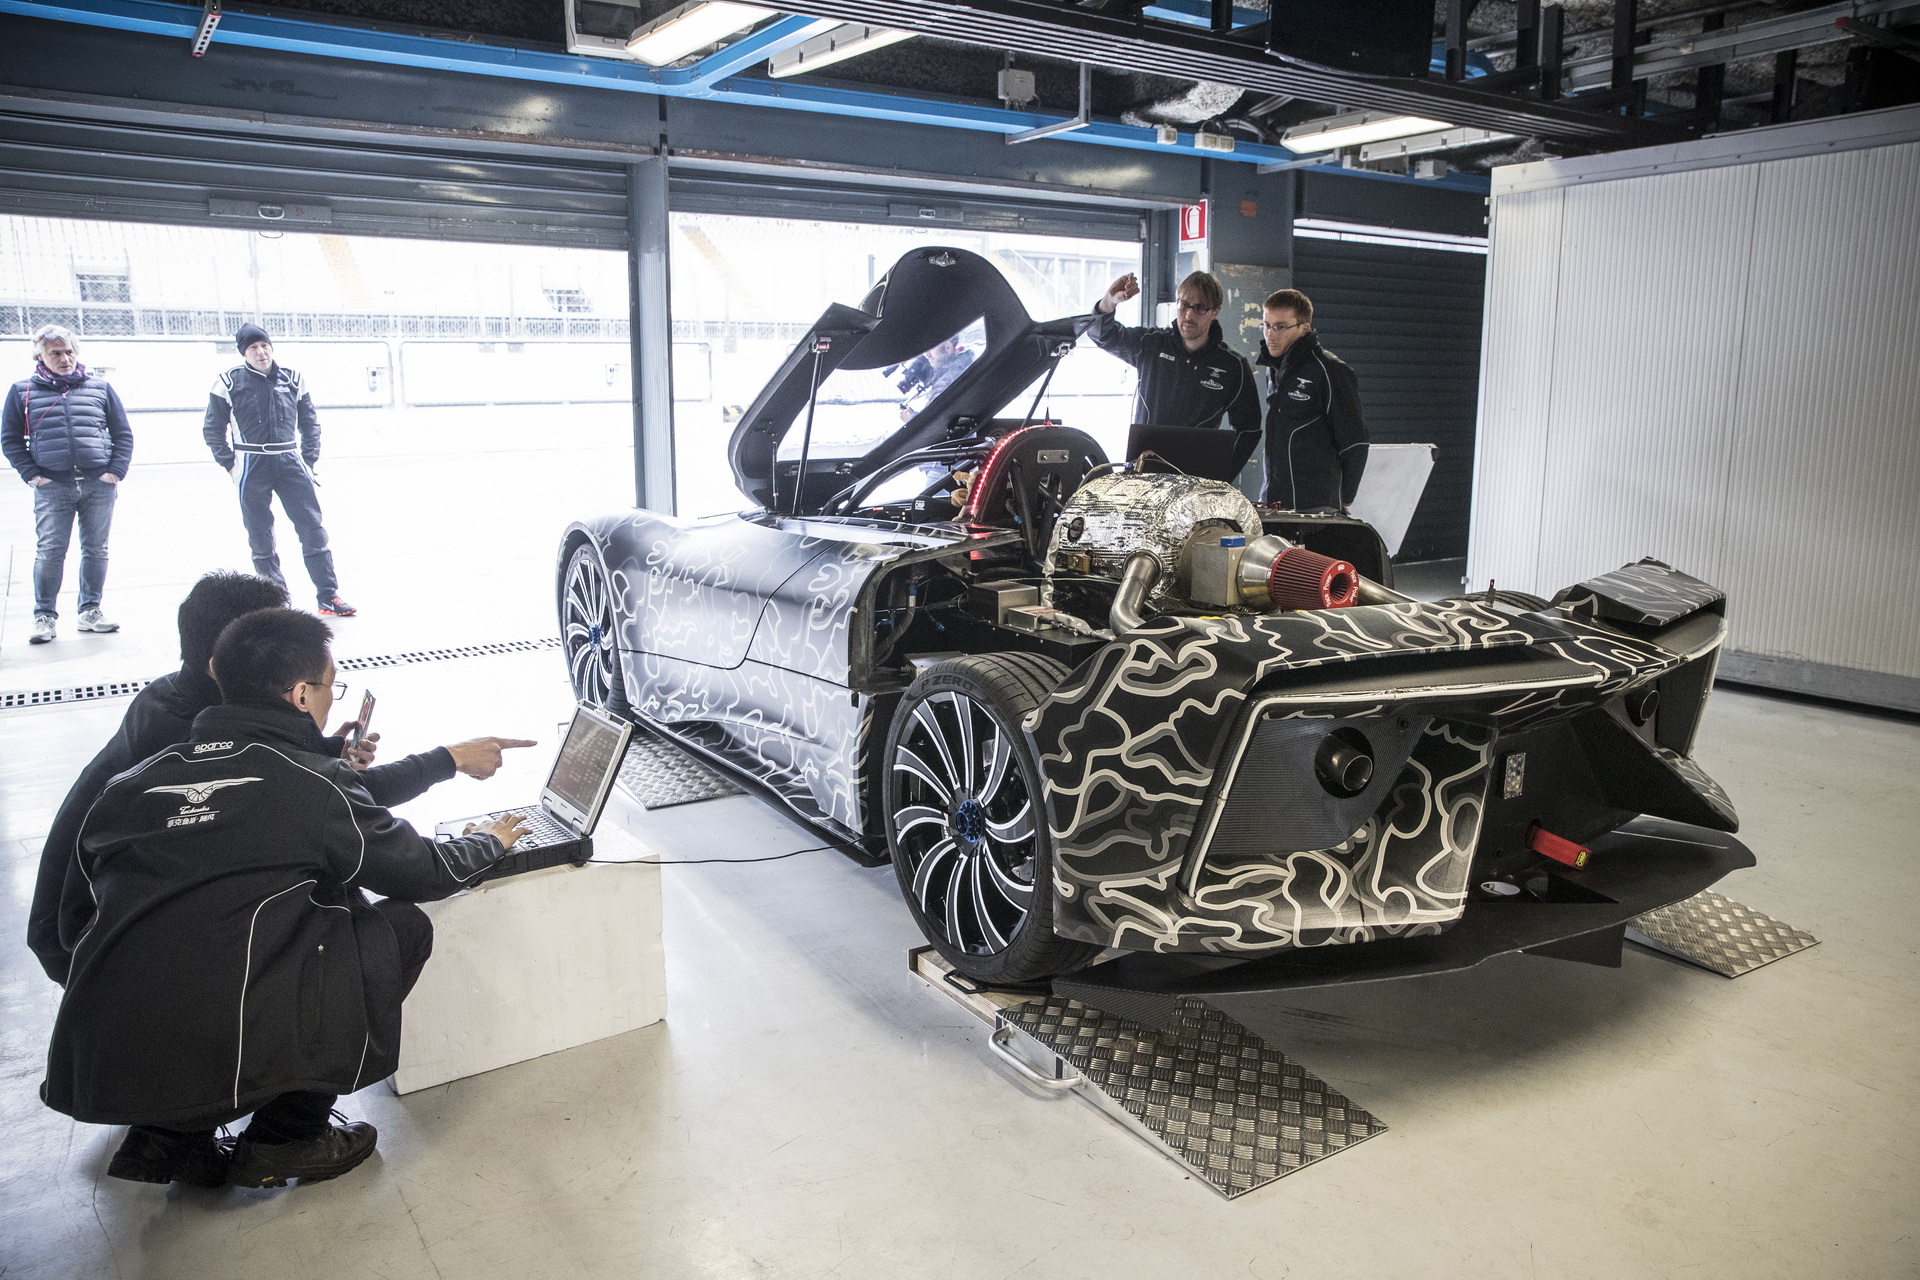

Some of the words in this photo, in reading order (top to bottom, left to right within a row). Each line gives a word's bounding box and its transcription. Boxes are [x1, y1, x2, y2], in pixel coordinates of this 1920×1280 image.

[921, 678, 930, 691] P
[932, 675, 974, 692] ZERO
[192, 741, 233, 753] sparco
